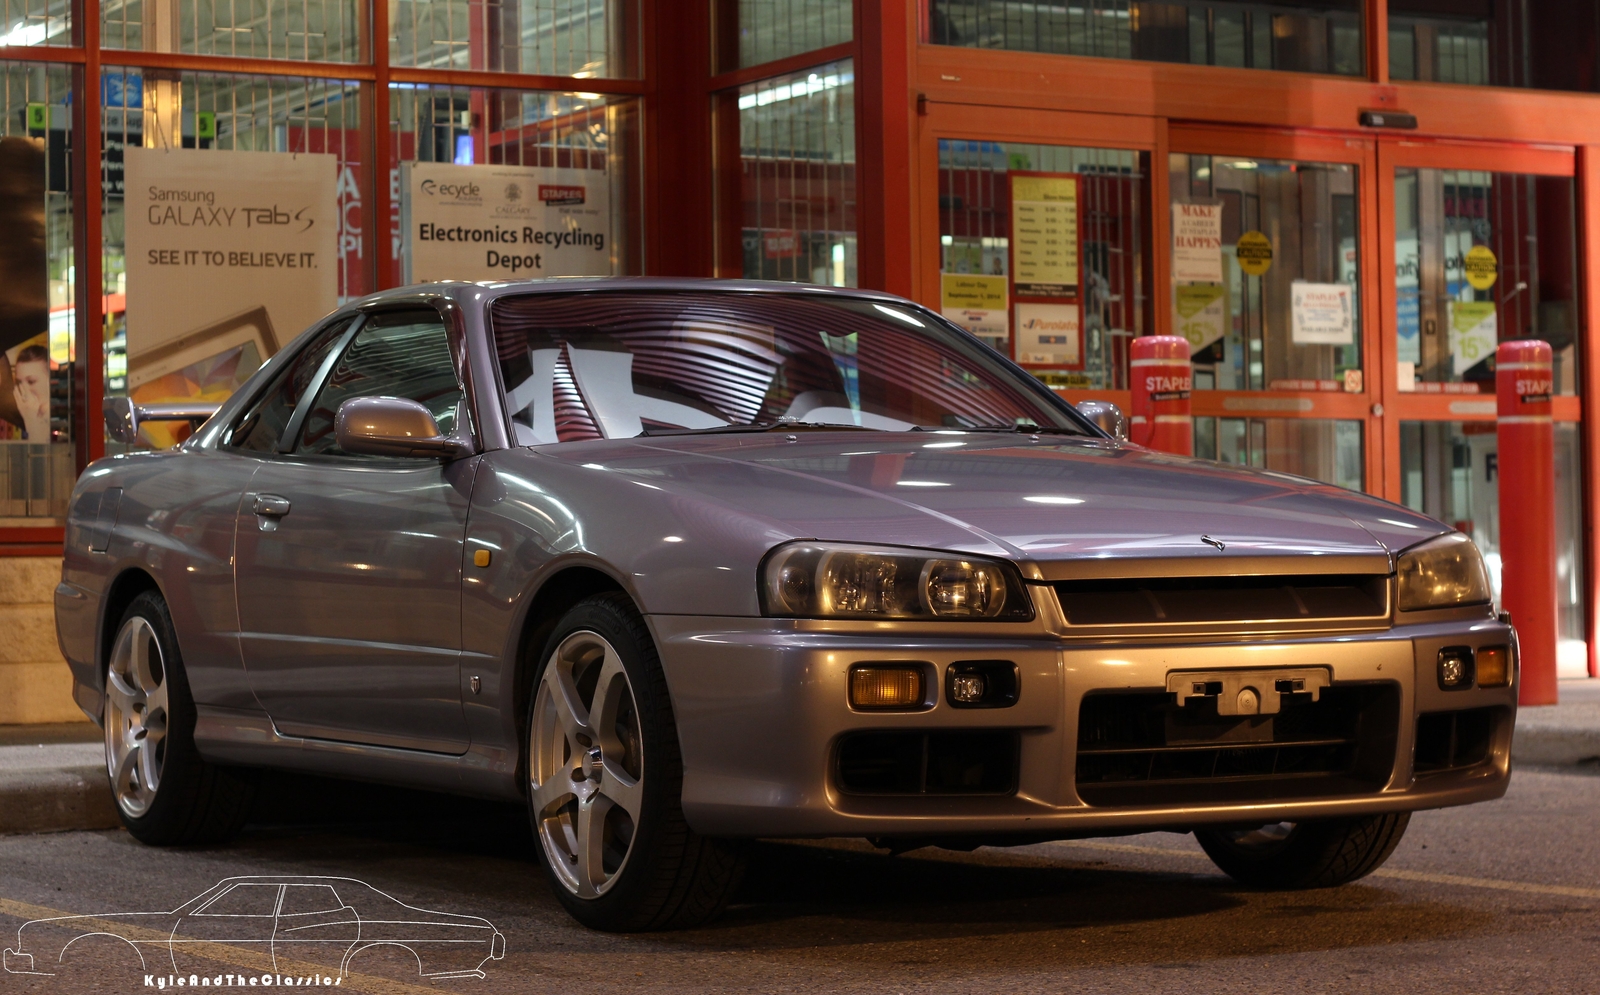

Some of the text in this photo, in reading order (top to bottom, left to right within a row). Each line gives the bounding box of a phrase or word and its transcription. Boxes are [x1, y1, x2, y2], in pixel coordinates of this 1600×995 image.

[148, 186, 215, 206] Samsung
[439, 181, 480, 199] ecycle
[542, 189, 582, 199] STAPLES
[148, 205, 236, 227] GALAXY
[241, 204, 290, 228] Tab
[1182, 205, 1215, 218] MAKE
[419, 222, 605, 251] Electronics Recycling
[1176, 236, 1222, 249] HAPPEN
[147, 250, 318, 269] SEE IT TO BELIEVE IT.
[487, 250, 541, 273] Depot
[948, 292, 975, 300] September
